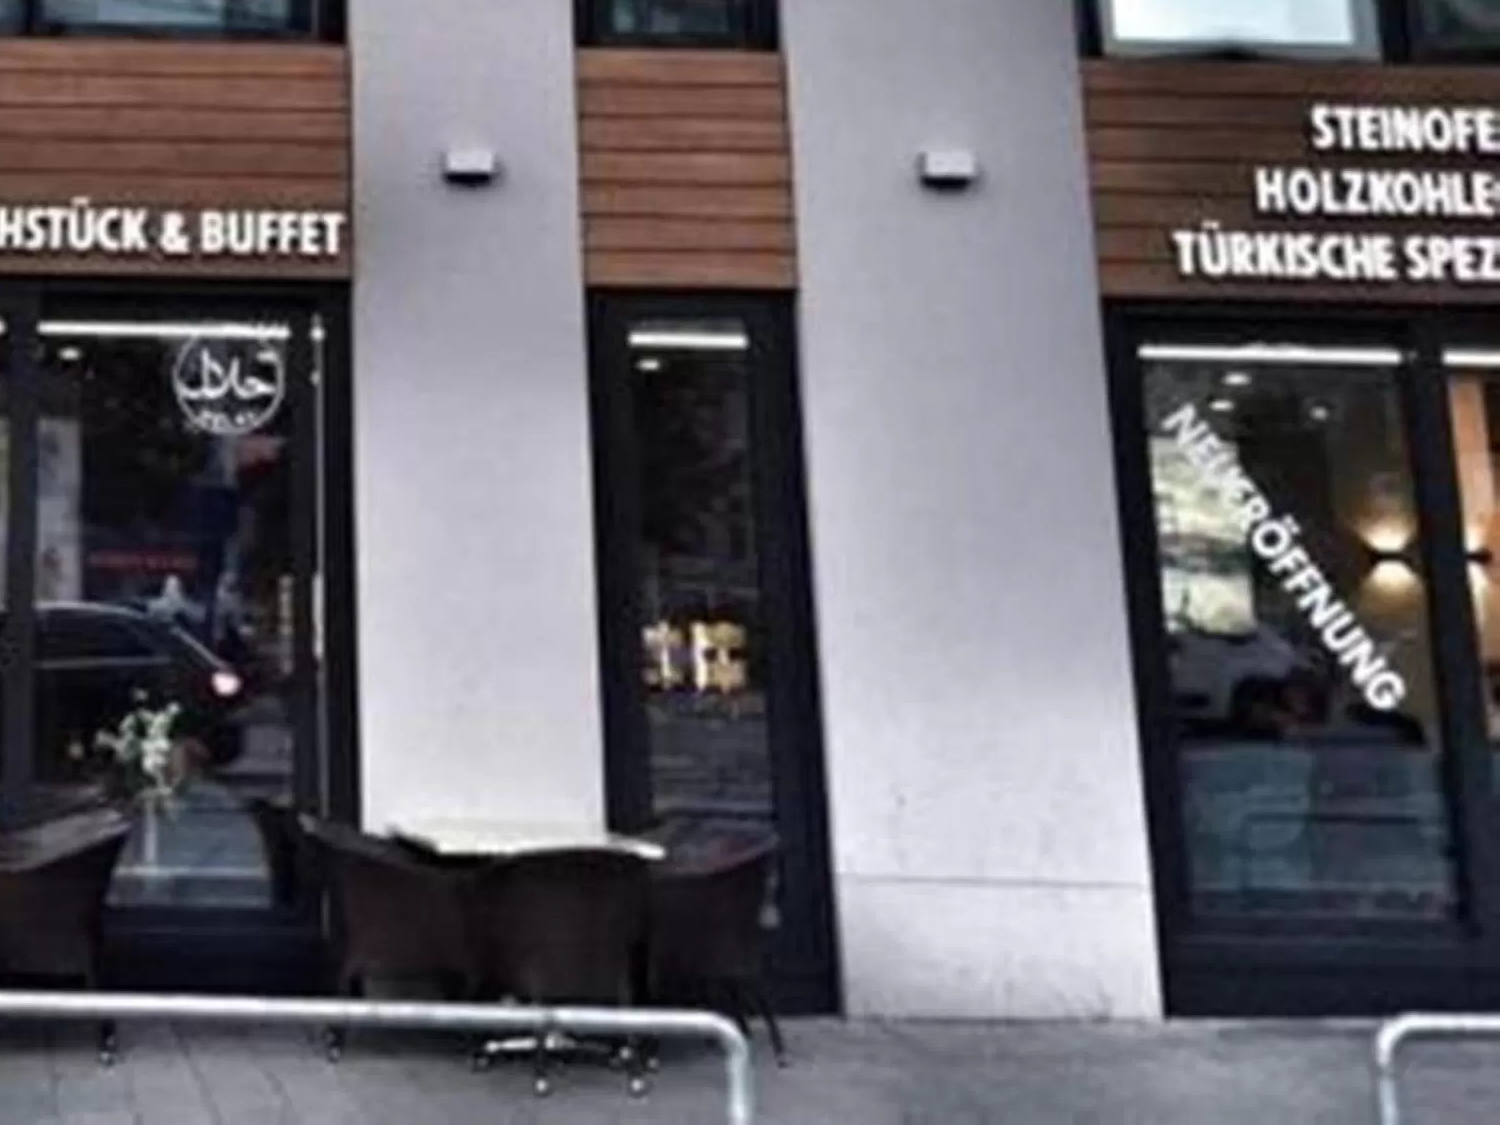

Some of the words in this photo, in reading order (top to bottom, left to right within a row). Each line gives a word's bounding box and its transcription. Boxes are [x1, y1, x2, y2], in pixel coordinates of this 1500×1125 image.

[1311, 104, 1500, 151] STEINOFE
[1255, 168, 1500, 216] HOLZKOHLE
[159, 212, 190, 254] &
[200, 210, 346, 255] BUFFET
[1172, 220, 1397, 279] TÜRKISCHE
[1403, 235, 1500, 280] SPEZ
[1161, 402, 1407, 711] NEUERÖFFNUNG
